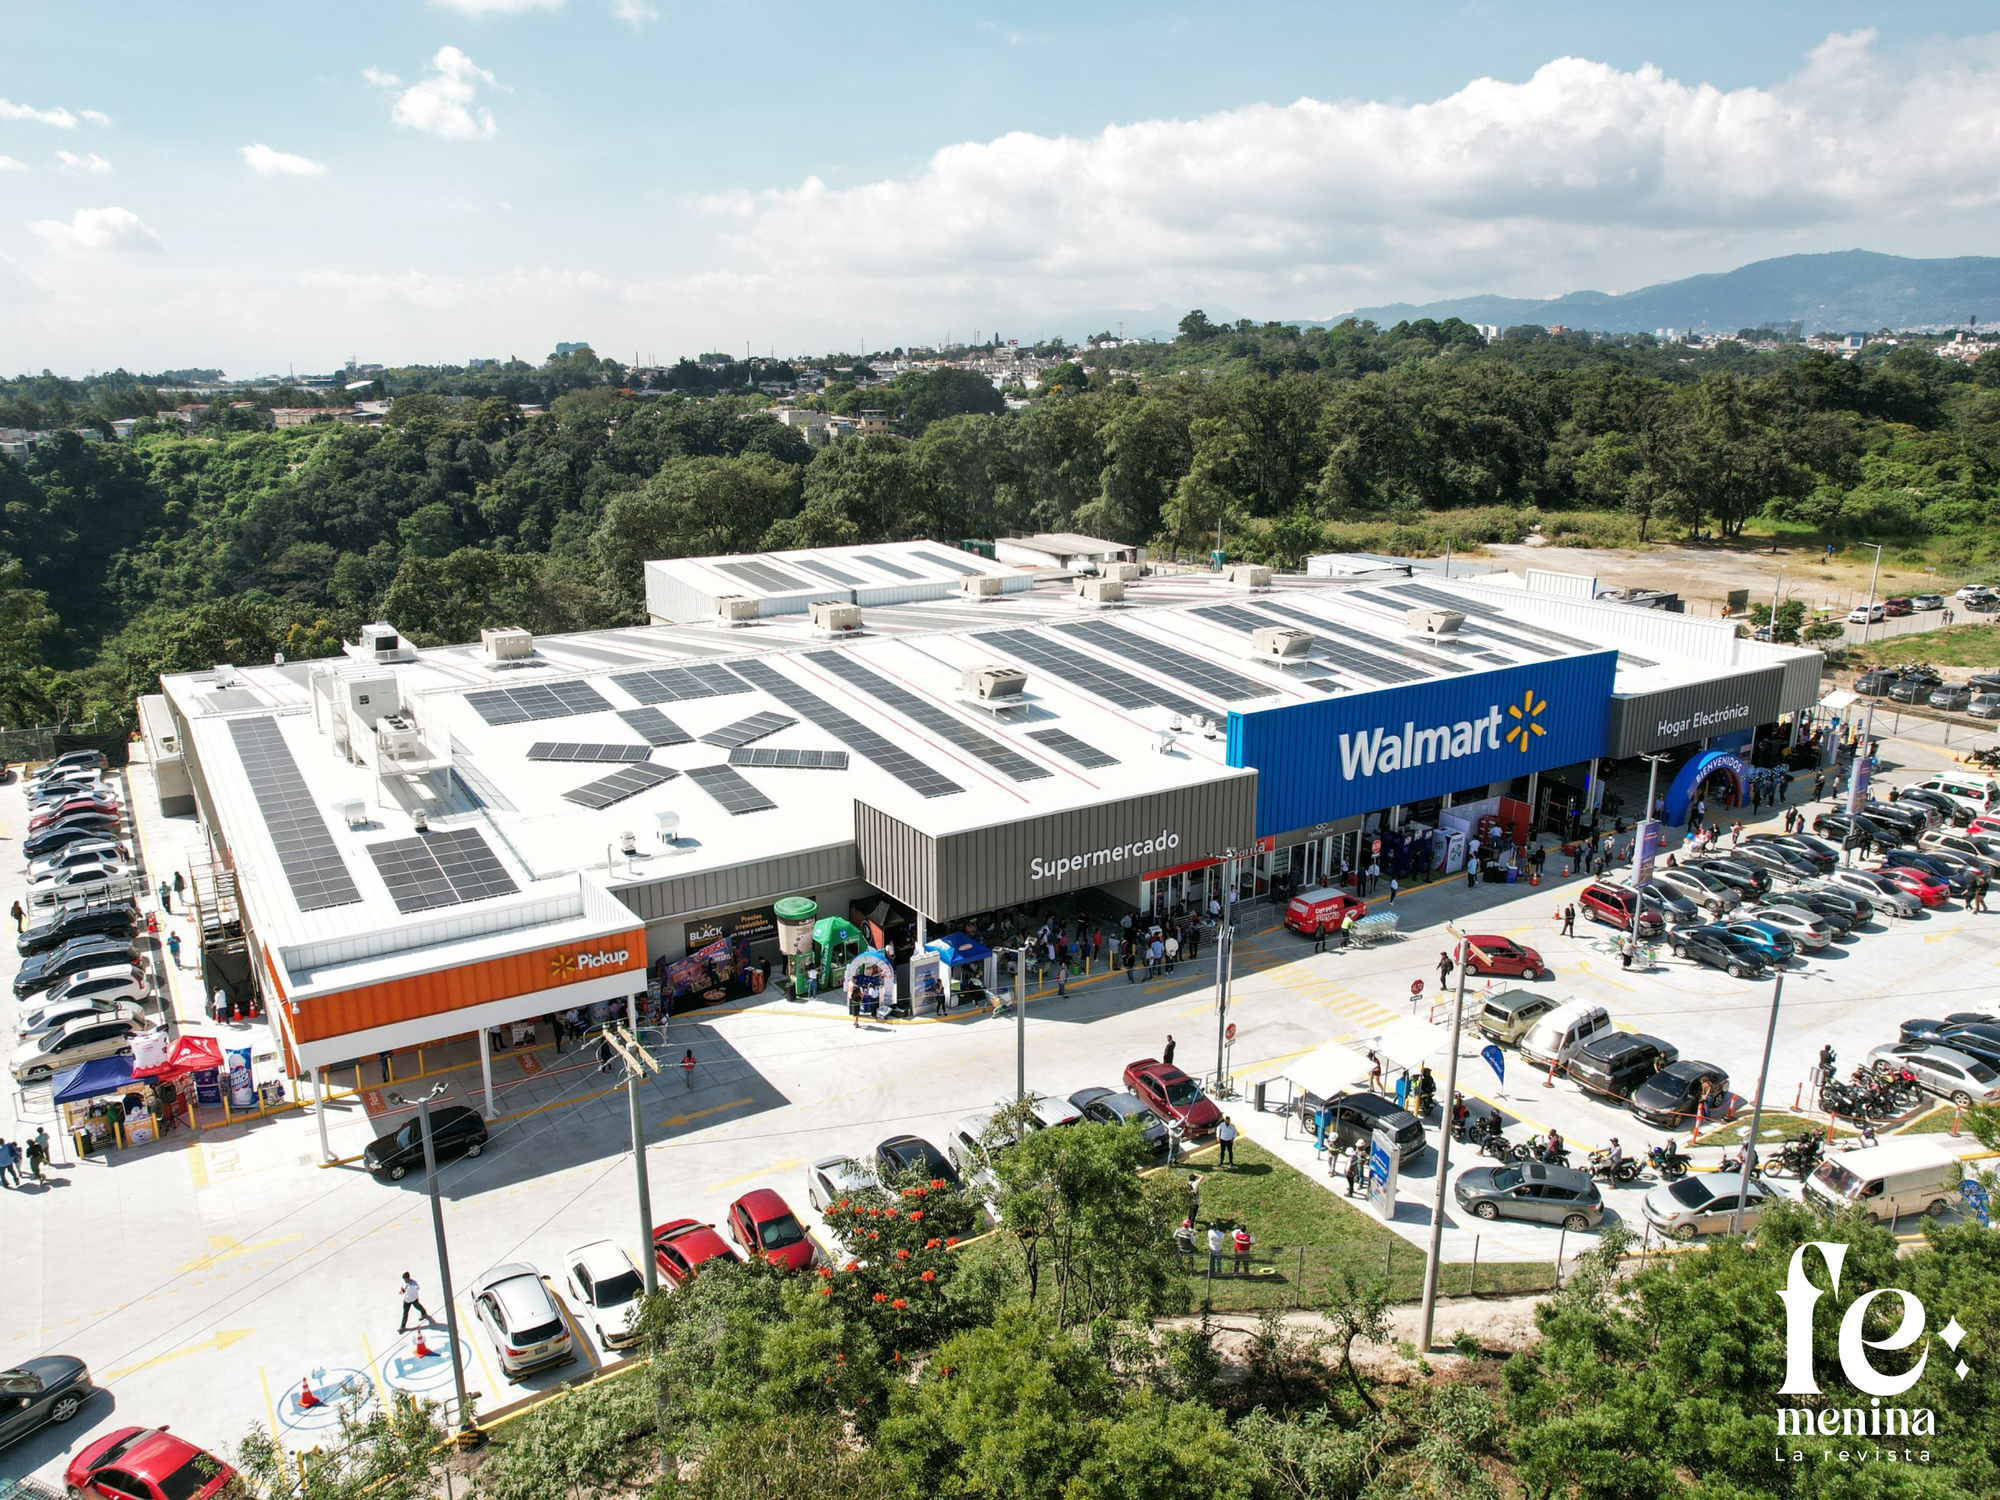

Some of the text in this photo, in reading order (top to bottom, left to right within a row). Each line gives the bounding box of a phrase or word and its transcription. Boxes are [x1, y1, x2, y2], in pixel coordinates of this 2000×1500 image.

[1657, 703, 1749, 737] Hogar Electrónica
[1338, 705, 1503, 781] Walmart
[1695, 756, 1743, 784] BIENVENIDOS
[1030, 829, 1179, 881] Supermercado
[735, 920, 768, 931] irresistibles
[741, 914, 762, 923] Precios
[755, 925, 774, 933] calzado
[689, 926, 724, 942] BLACK
[577, 949, 629, 970] Pickup
